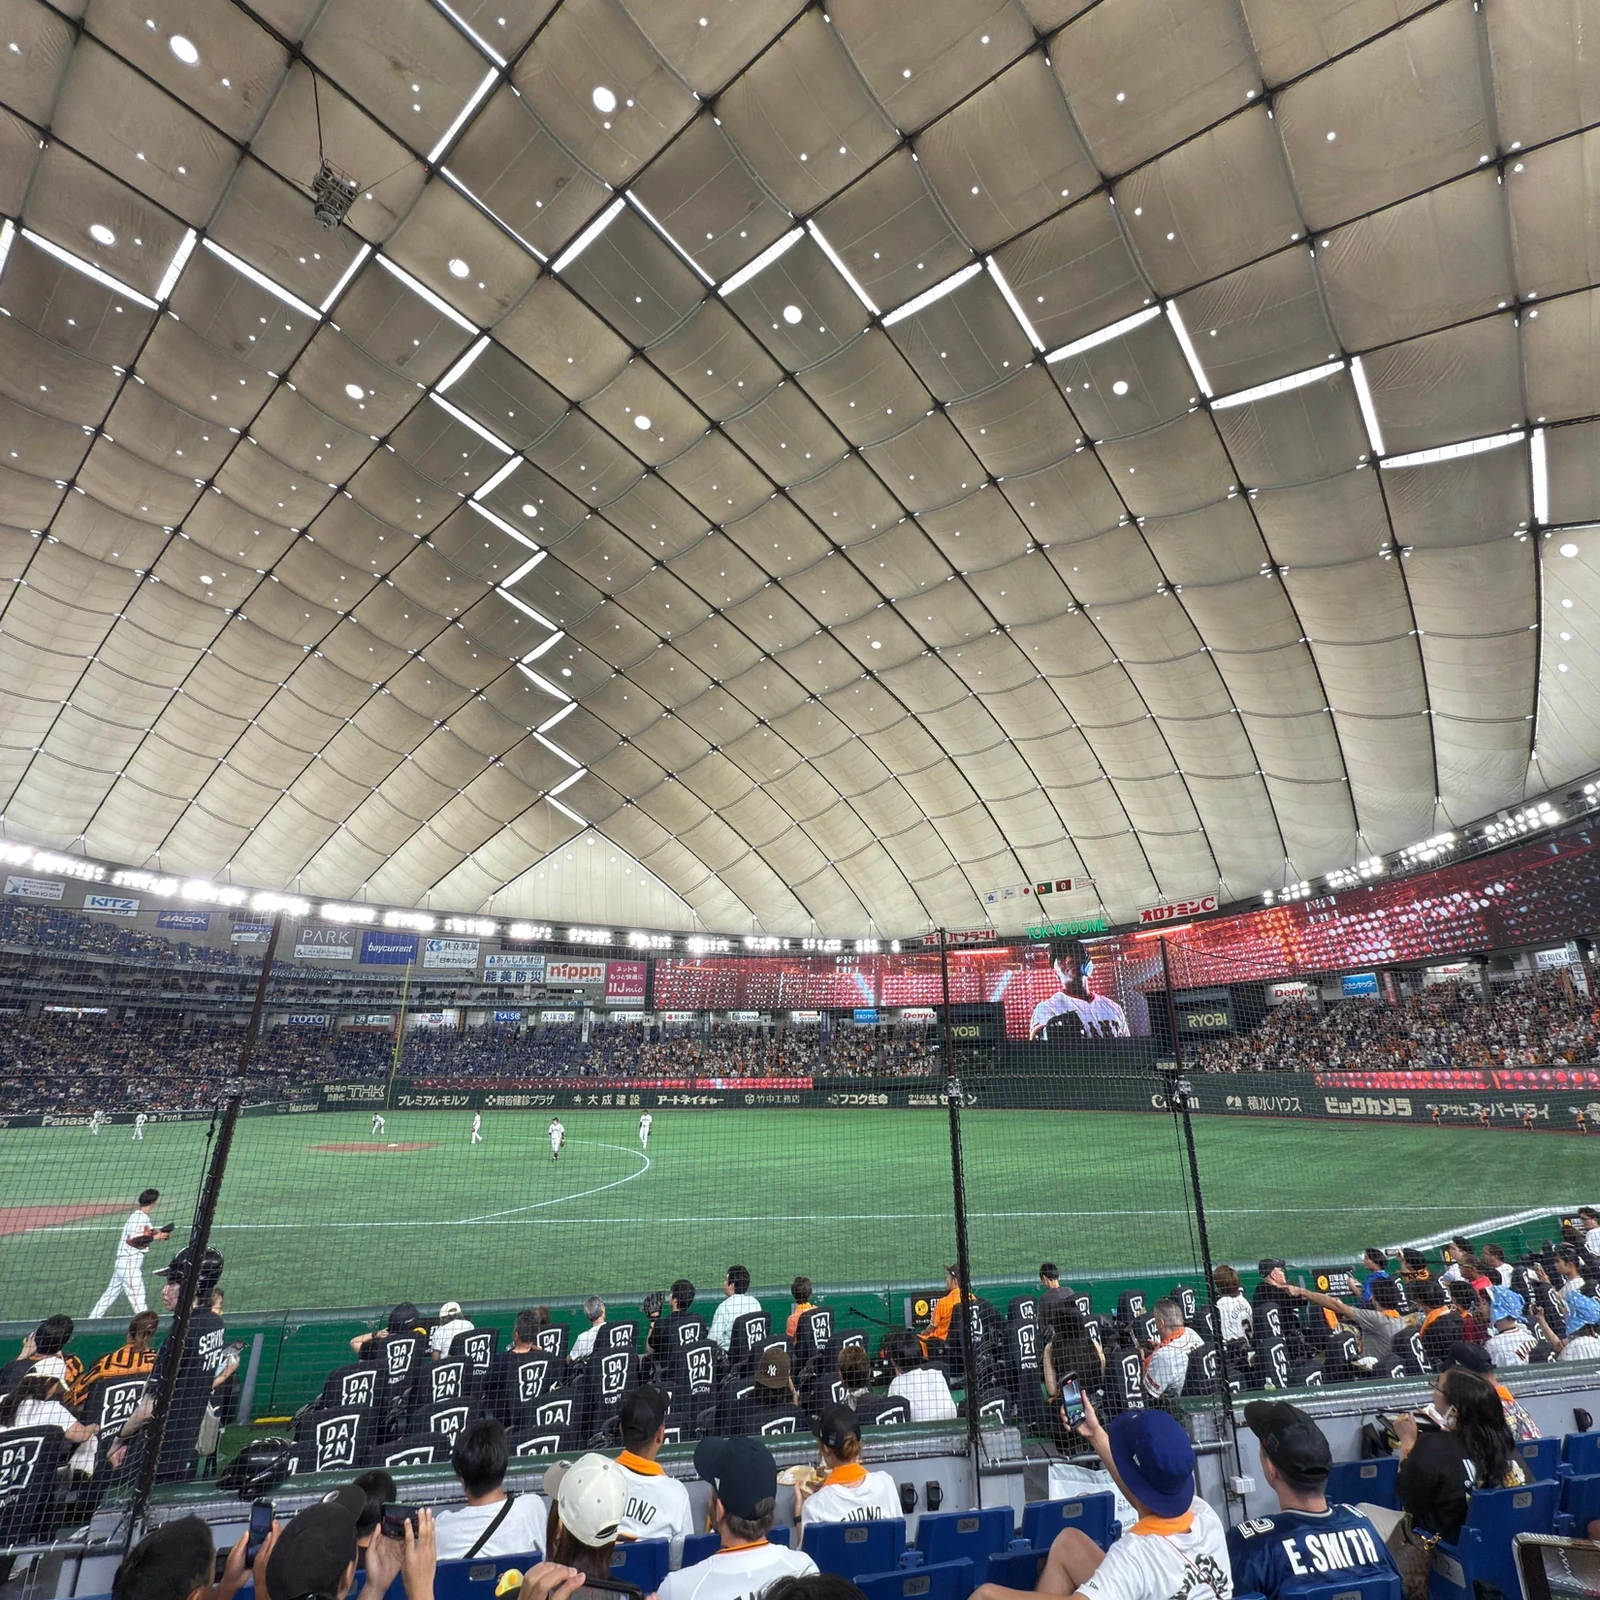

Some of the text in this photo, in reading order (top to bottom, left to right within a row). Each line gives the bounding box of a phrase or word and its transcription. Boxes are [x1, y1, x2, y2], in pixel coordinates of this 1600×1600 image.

[91, 896, 134, 908] KITZ
[1140, 896, 1216, 923] オロナミンC
[1026, 918, 1108, 940] TOKYO DOME
[302, 929, 350, 944] PARK
[368, 942, 412, 954] baycurrent
[496, 956, 542, 964] あんしん財団
[486, 970, 542, 982] 能美防災
[550, 963, 601, 980] nippn
[608, 982, 643, 993] IIJmio
[1274, 988, 1304, 998] Deny
[290, 1015, 325, 1024] TOTO
[542, 1012, 574, 1020] 大塚商会
[904, 1012, 936, 1020] Denyo
[1188, 1012, 1228, 1028] RYOBI
[944, 1026, 980, 1038] YOBI
[348, 1084, 386, 1097] THK
[398, 1094, 469, 1106] プレミアム・モルツ
[496, 1094, 555, 1106] 新宿健診プラザ
[588, 1094, 640, 1106] 大成建設
[657, 1094, 724, 1104] アートネイチャー
[757, 1094, 800, 1104] 竹中工務店
[840, 1094, 888, 1105] フコク生命
[940, 1094, 978, 1106] セン
[1247, 1096, 1302, 1112] 積水ハウス
[1324, 1096, 1412, 1116] ビックカメラ
[41, 1115, 112, 1126] Panasoic
[158, 1112, 182, 1122] Trunk
[198, 1328, 225, 1355] SERVIC
[622, 1496, 656, 1526] ONO
[1282, 1528, 1379, 1576] E.SMITH
